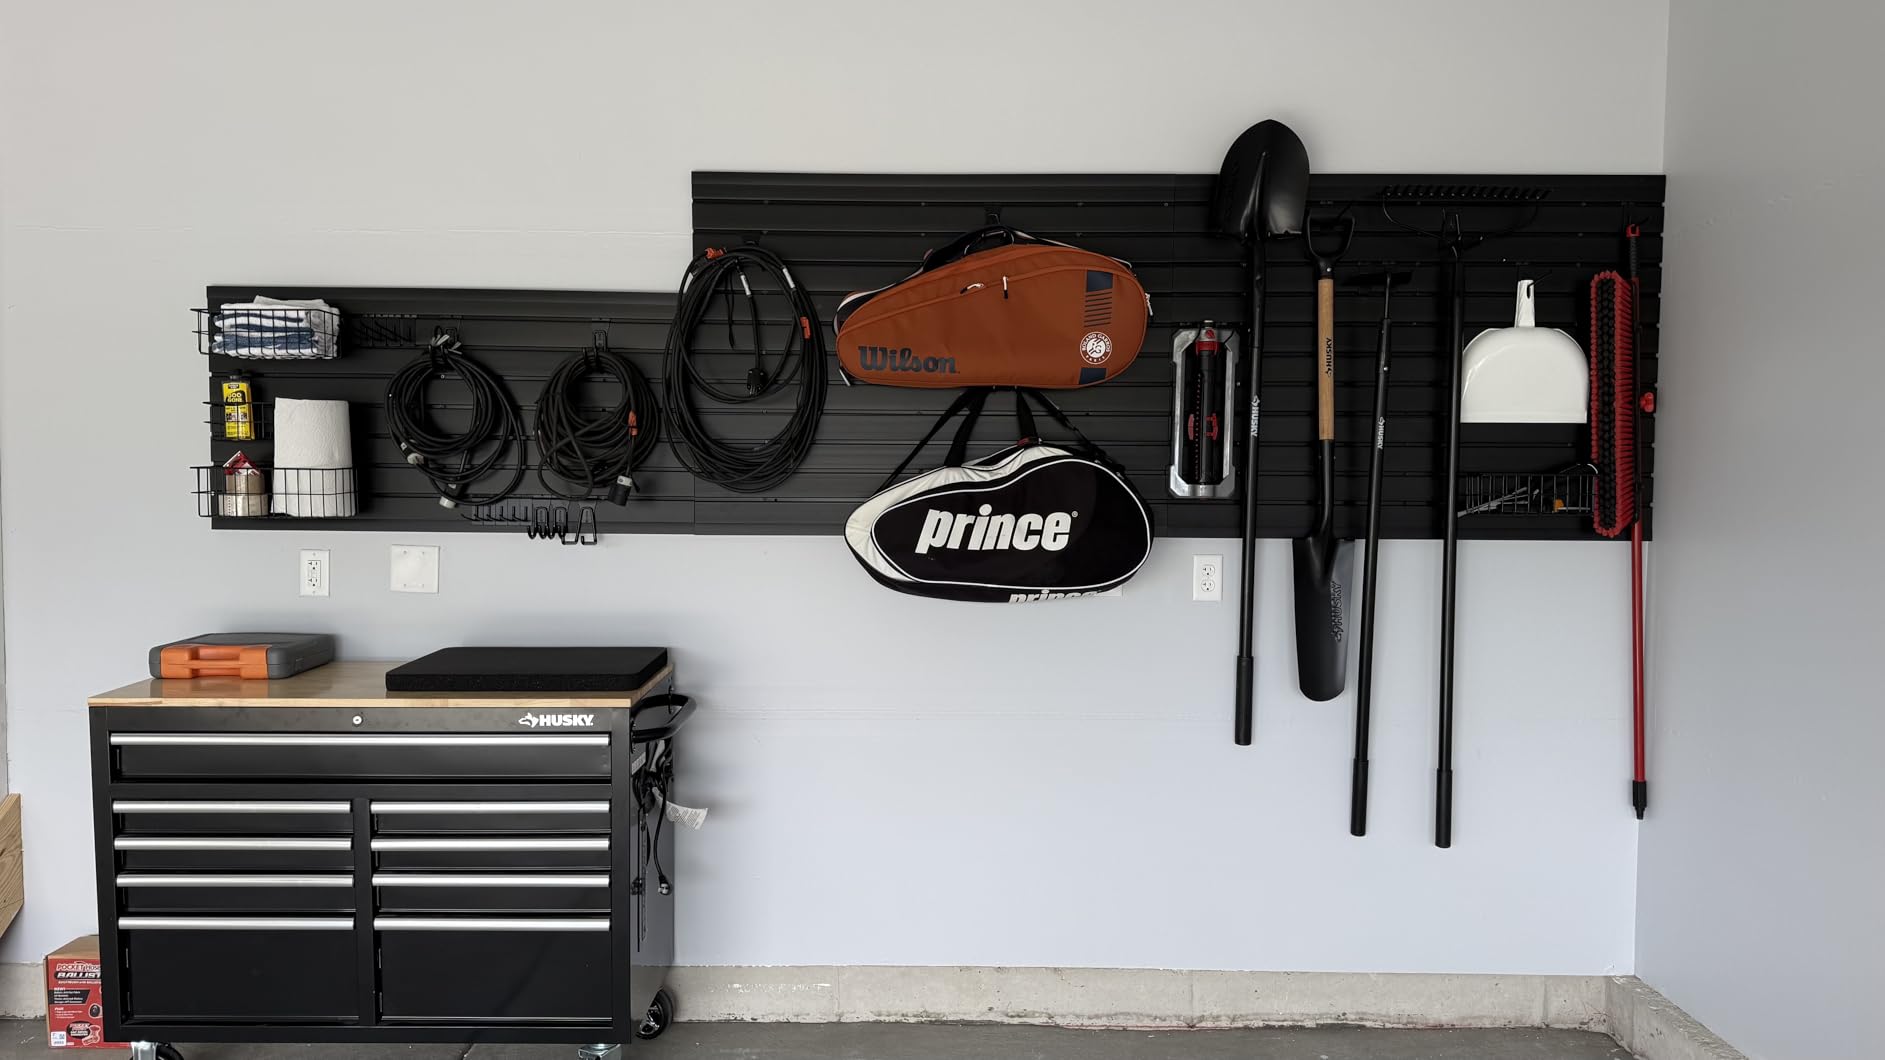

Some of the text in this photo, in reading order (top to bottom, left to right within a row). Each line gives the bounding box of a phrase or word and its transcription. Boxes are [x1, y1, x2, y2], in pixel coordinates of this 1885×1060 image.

[858, 346, 957, 374] Wilson
[1325, 336, 1333, 367] HUSKY
[1250, 406, 1260, 438] HUSKY
[1377, 425, 1386, 450] HUSKY
[1330, 580, 1343, 626] HUSKY
[539, 714, 595, 727] HUSKY
